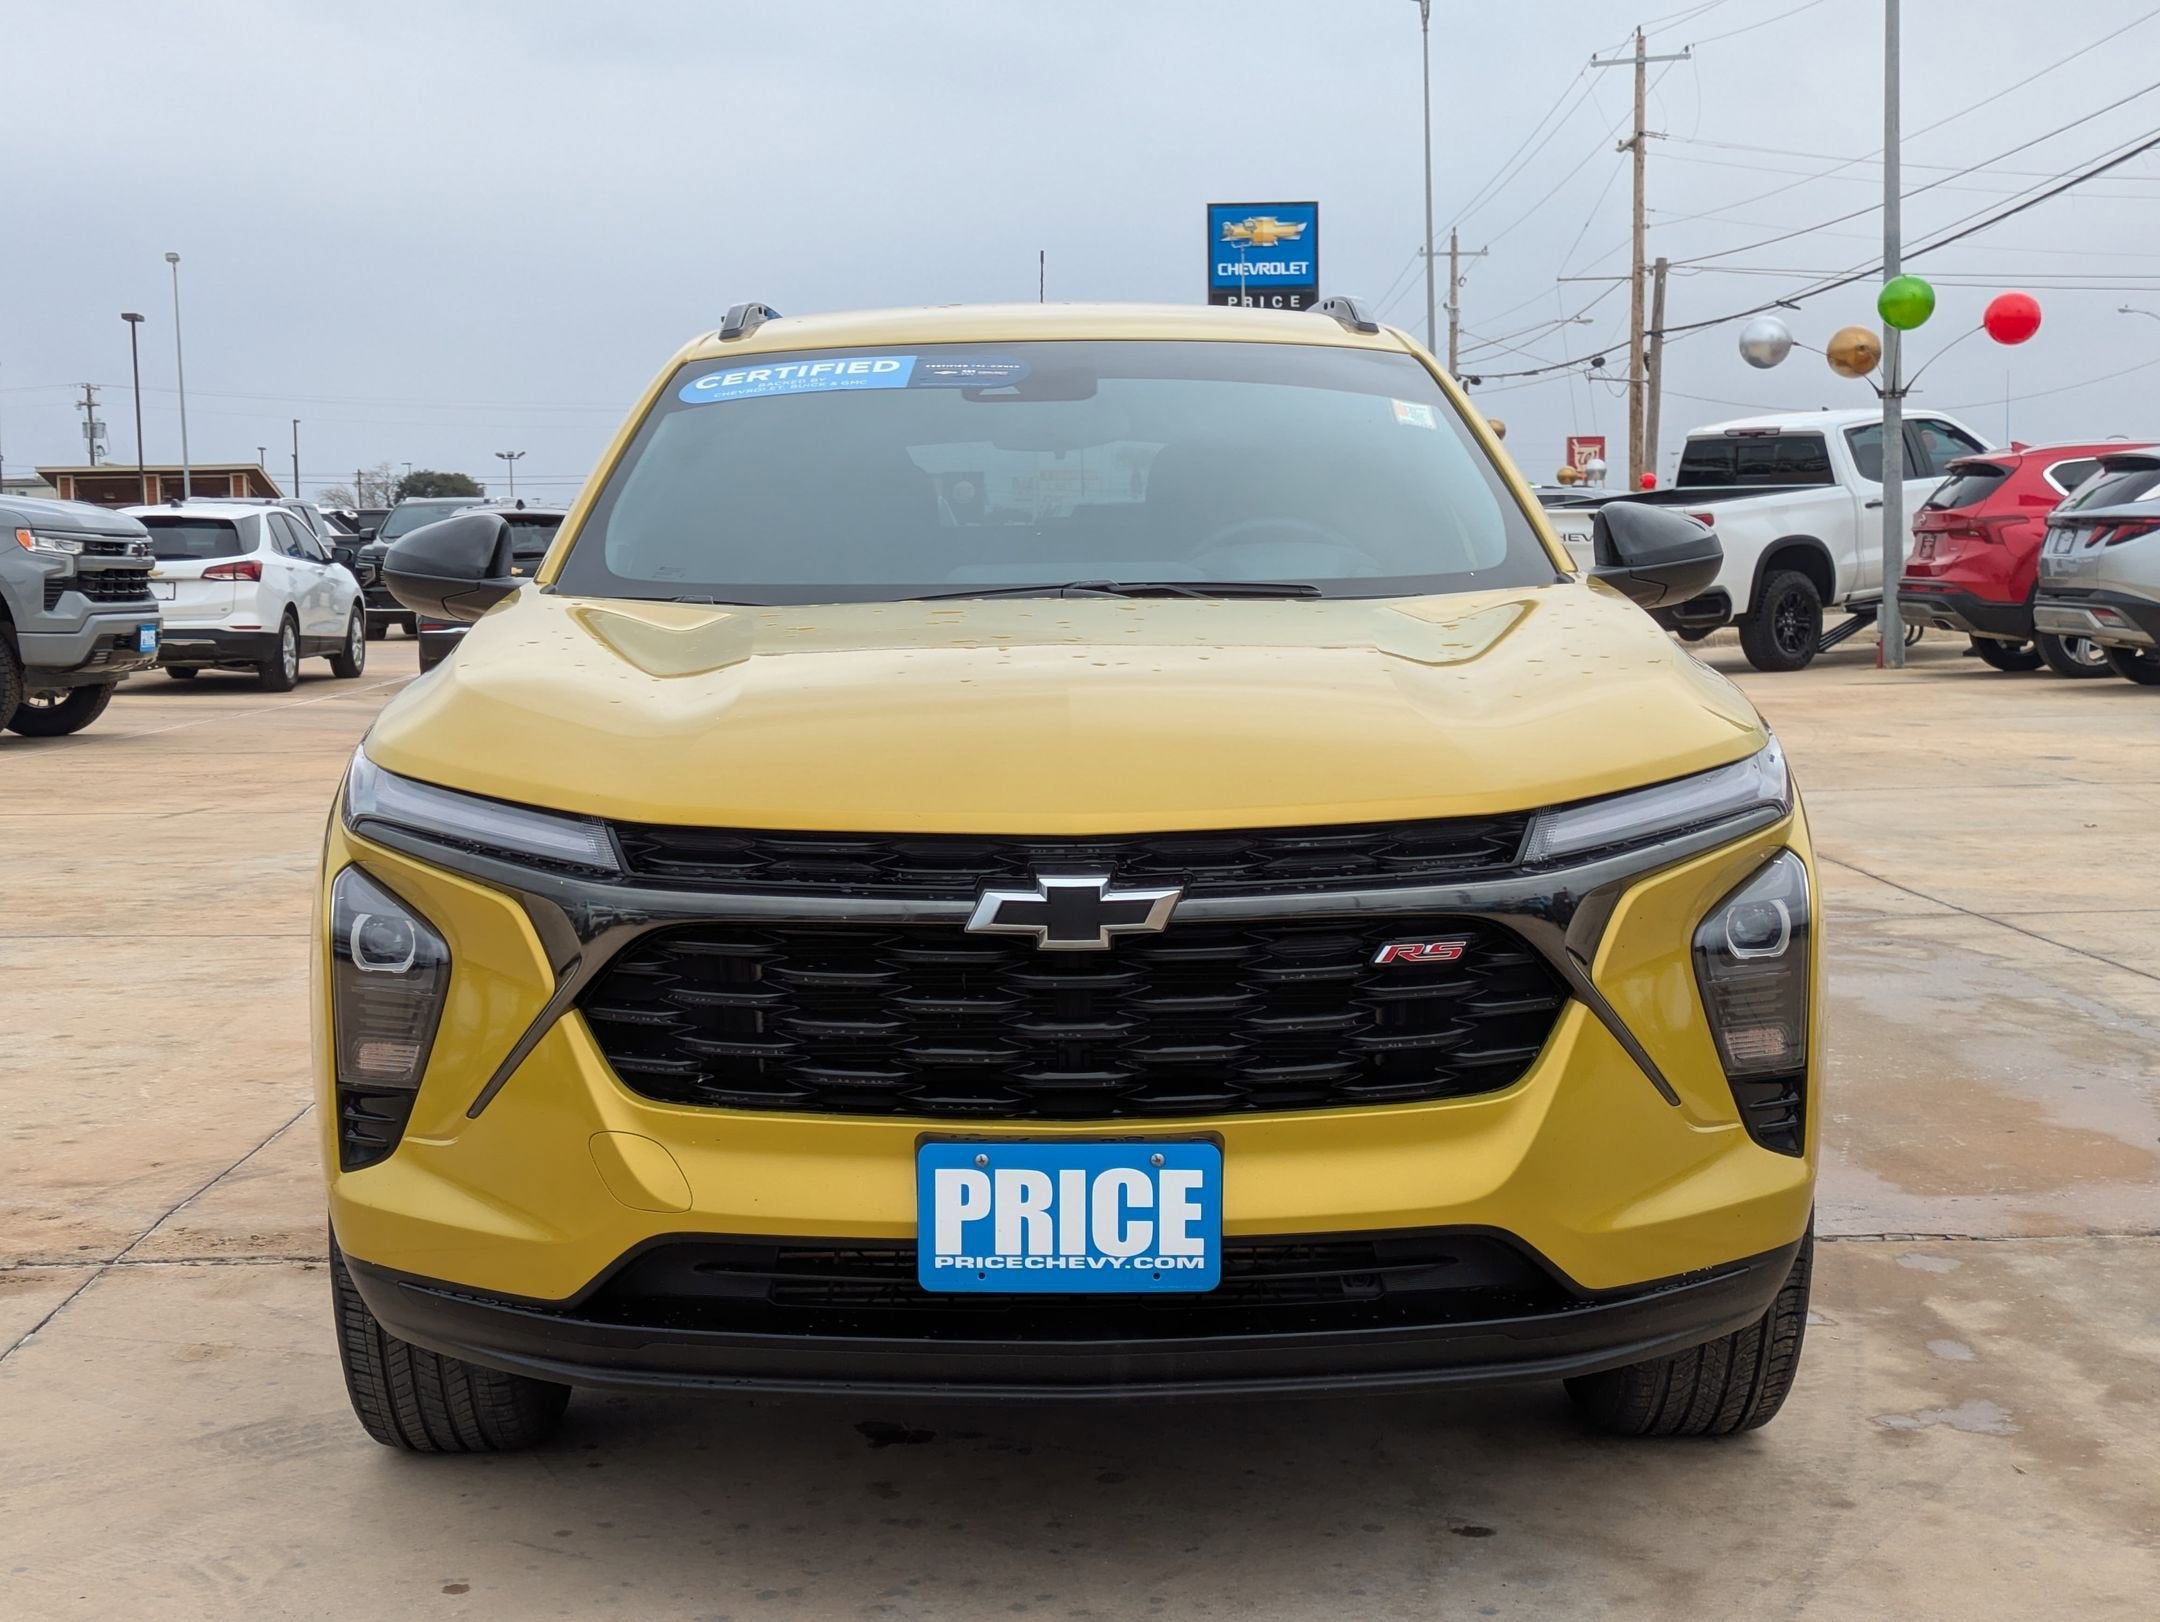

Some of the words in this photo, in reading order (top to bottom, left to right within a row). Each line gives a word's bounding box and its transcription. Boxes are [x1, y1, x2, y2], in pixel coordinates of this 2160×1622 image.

[1217, 261, 1309, 276] CHEVROLET
[1228, 295, 1301, 308] PRICE
[695, 360, 901, 390] CERTIFIED
[758, 378, 806, 388] BACKED
[1374, 941, 1467, 964] RS
[934, 1167, 1205, 1257] PRICE
[934, 1256, 1205, 1269] PRICECHEVY.COM
